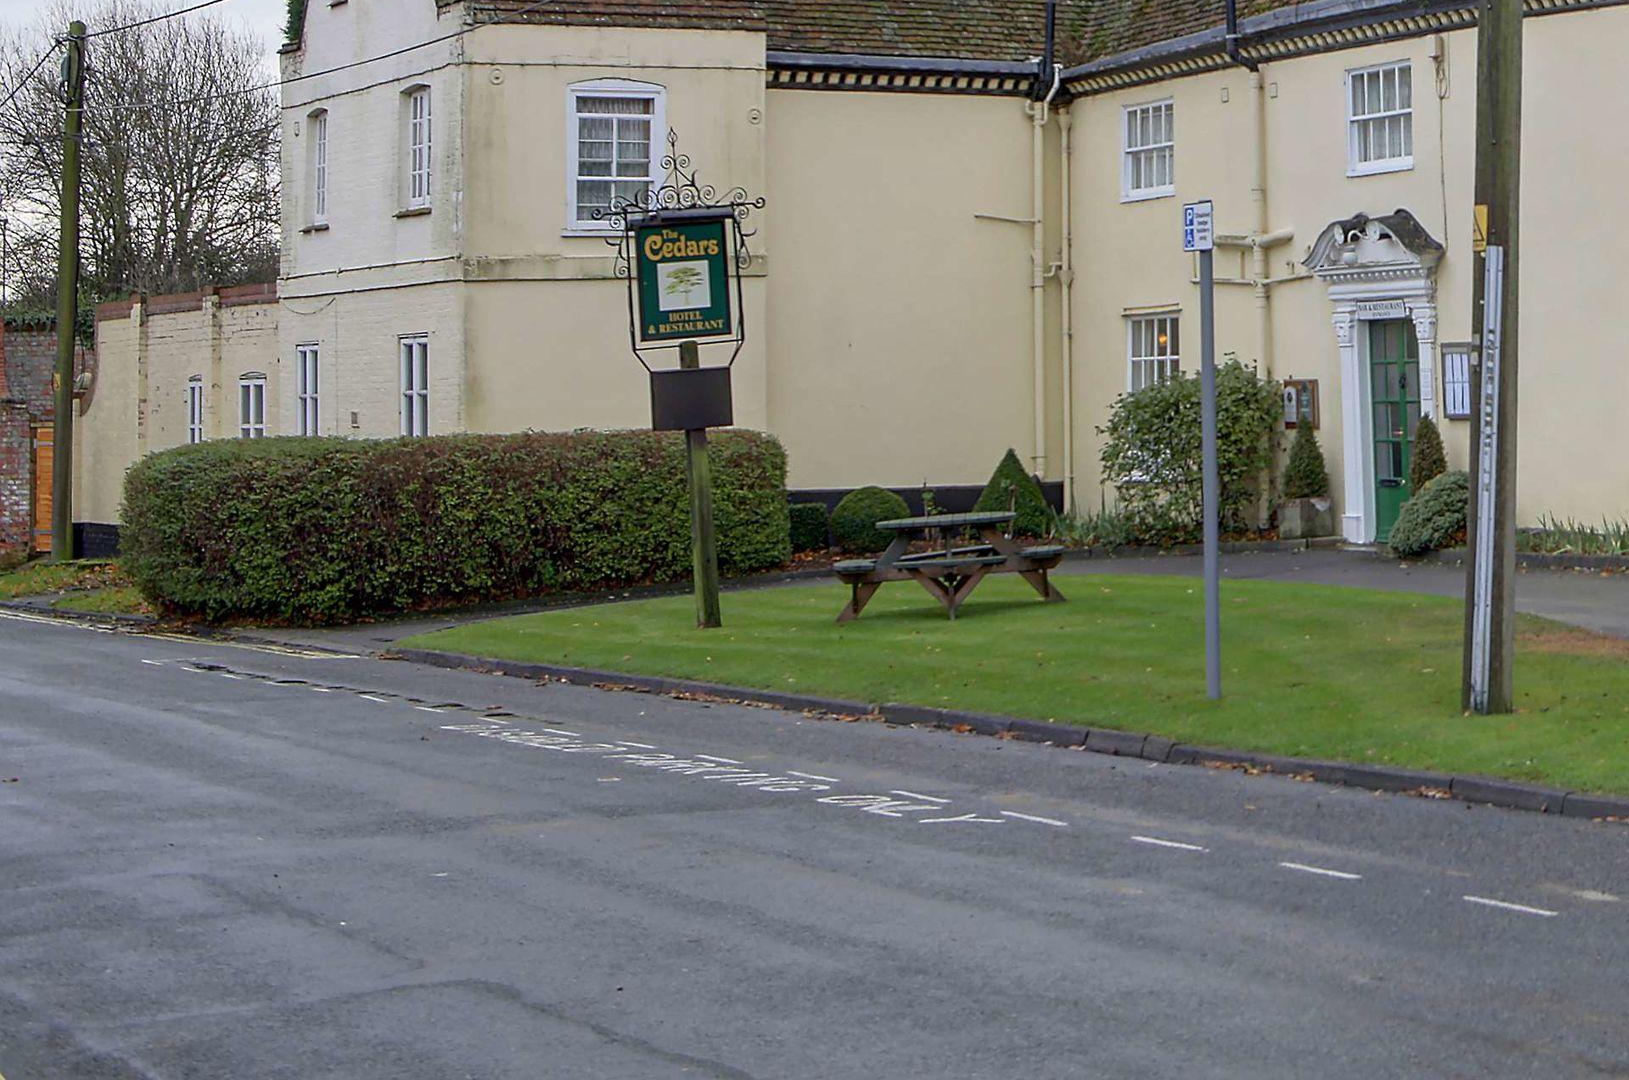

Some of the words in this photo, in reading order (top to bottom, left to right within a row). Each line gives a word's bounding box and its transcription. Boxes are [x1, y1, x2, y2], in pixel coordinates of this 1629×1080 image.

[1186, 209, 1193, 225] P
[661, 229, 679, 240] The
[644, 234, 720, 261] Cedars
[668, 310, 704, 322] HOTEL
[647, 324, 656, 334] &
[659, 319, 724, 333] RESTAURANT
[817, 794, 1005, 823] ONLY
